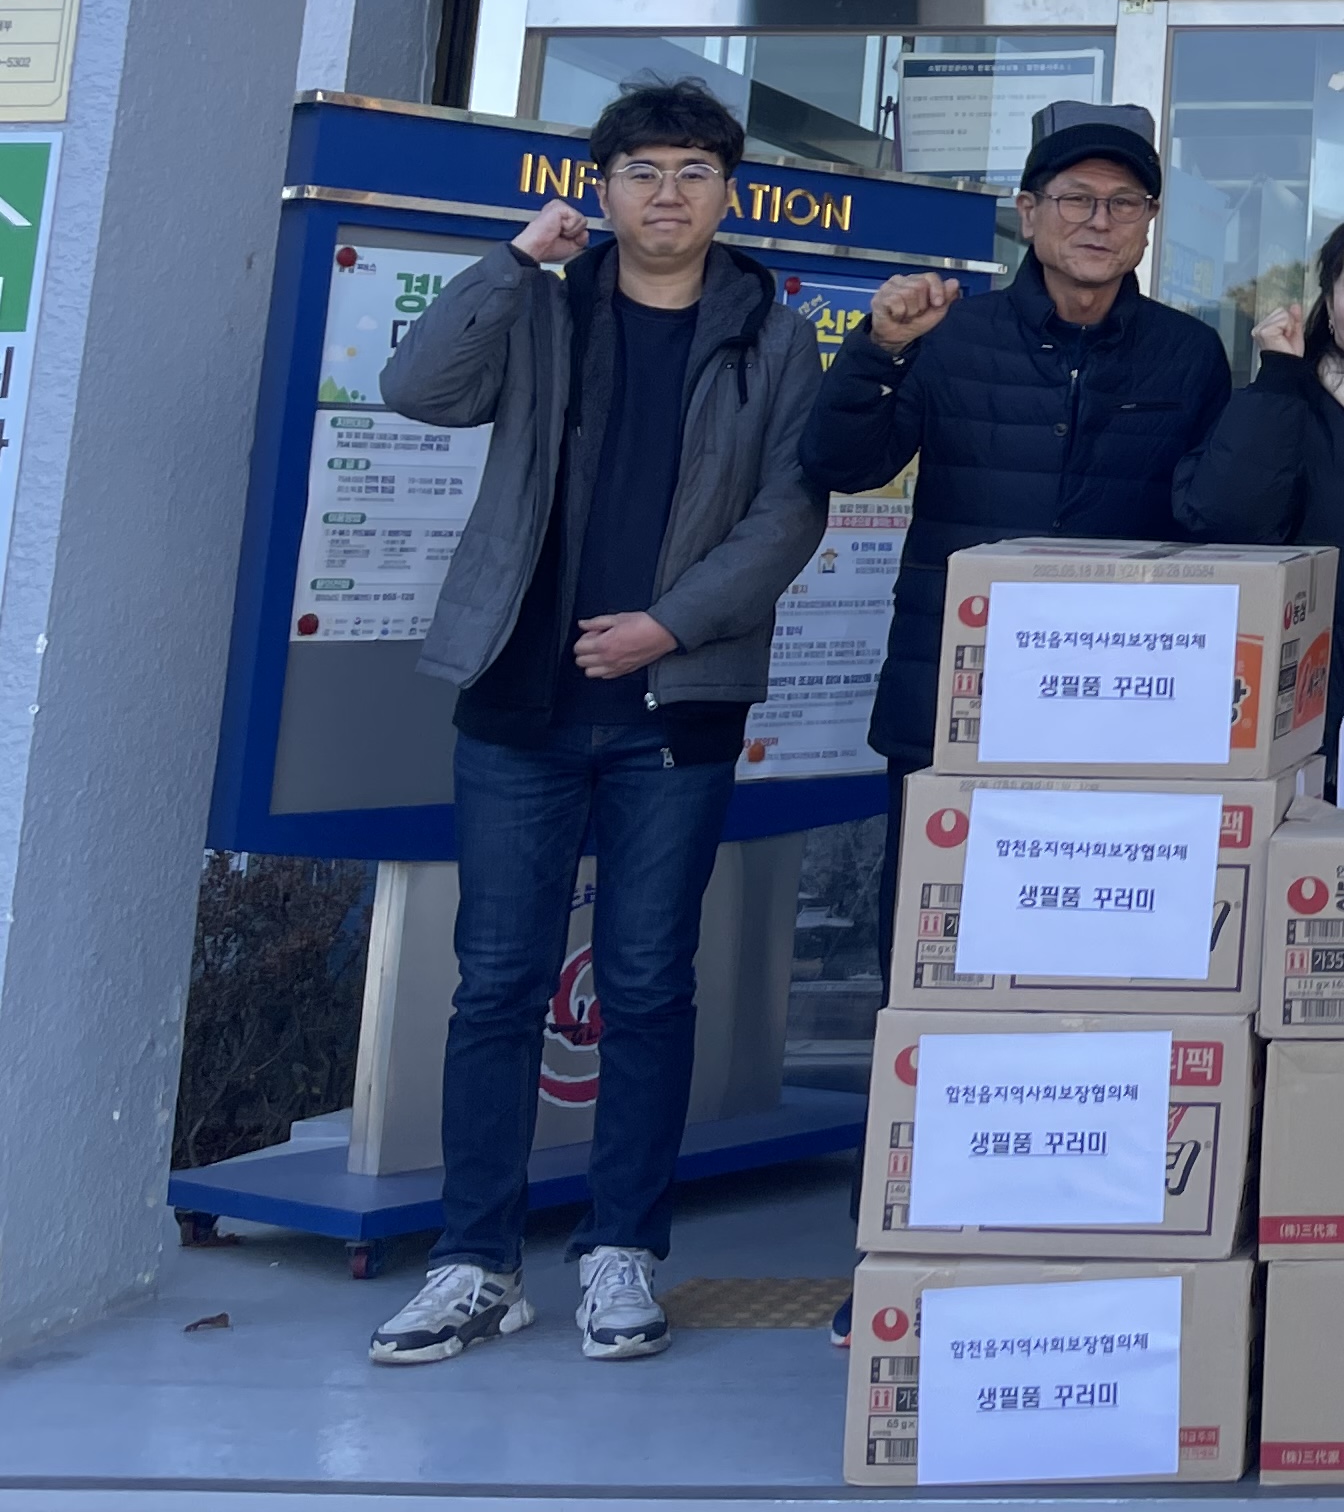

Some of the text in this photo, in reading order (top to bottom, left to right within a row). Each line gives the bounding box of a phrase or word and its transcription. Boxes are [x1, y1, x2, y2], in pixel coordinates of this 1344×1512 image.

[519, 152, 852, 231] INFATION
[1016, 631, 1205, 650] 합천읍지역사회보장협의체
[1040, 676, 1174, 699] 생필품 꾸러미
[997, 840, 1187, 861] 합천읍지역사회보장협의체
[1019, 886, 1154, 910] 생필품 꾸러미
[947, 1084, 1138, 1104] 합천읍지역사회보장협의체
[971, 1132, 1106, 1156] 생필품 꾸러미
[951, 1333, 1148, 1359] 합천읍지역사회보장협의체
[978, 1383, 1117, 1411] 생필품 꾸러미
